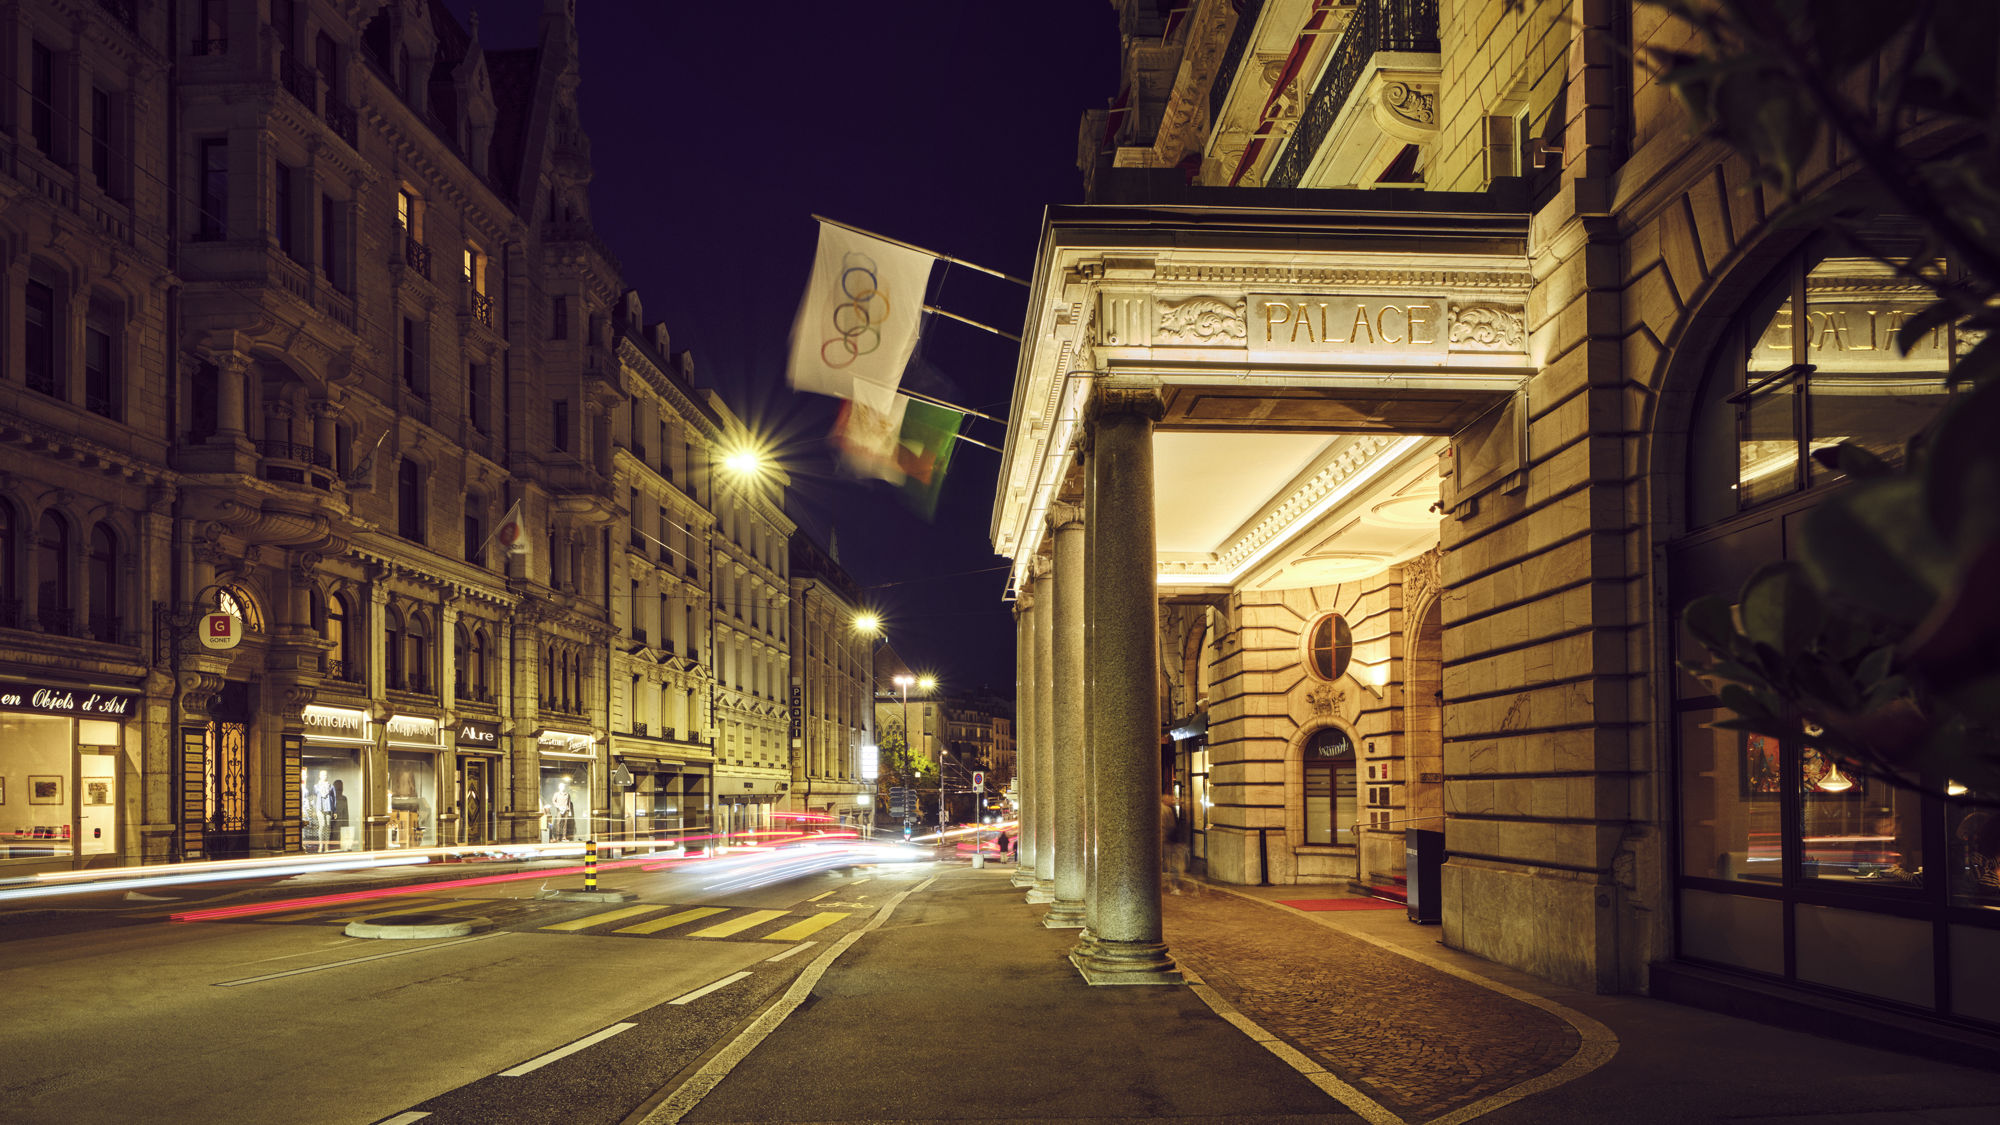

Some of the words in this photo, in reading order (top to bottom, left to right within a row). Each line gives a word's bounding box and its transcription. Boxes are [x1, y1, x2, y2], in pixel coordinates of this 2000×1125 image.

[1265, 302, 1435, 345] PALACE
[214, 620, 225, 632] G
[1, 694, 21, 706] en
[32, 688, 74, 710] Objets
[301, 713, 359, 730] CORTIGIANI
[460, 726, 494, 742] Allure
